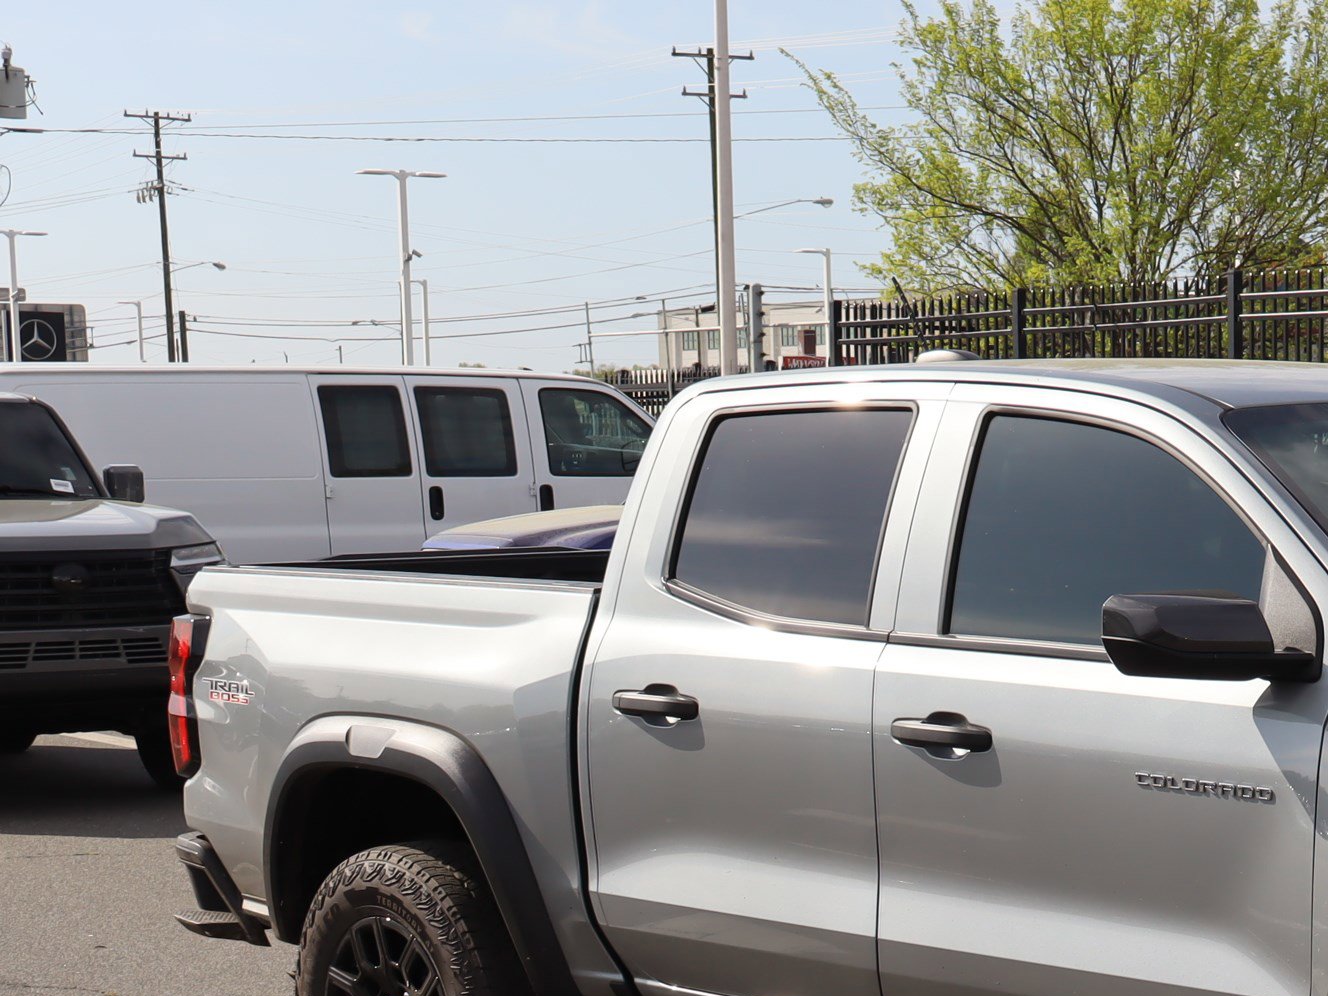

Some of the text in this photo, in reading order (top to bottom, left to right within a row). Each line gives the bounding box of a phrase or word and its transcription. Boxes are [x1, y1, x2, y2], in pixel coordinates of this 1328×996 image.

[202, 677, 255, 697] TRAIL
[209, 690, 249, 705] BOSS
[1134, 771, 1274, 802] COLORADO
